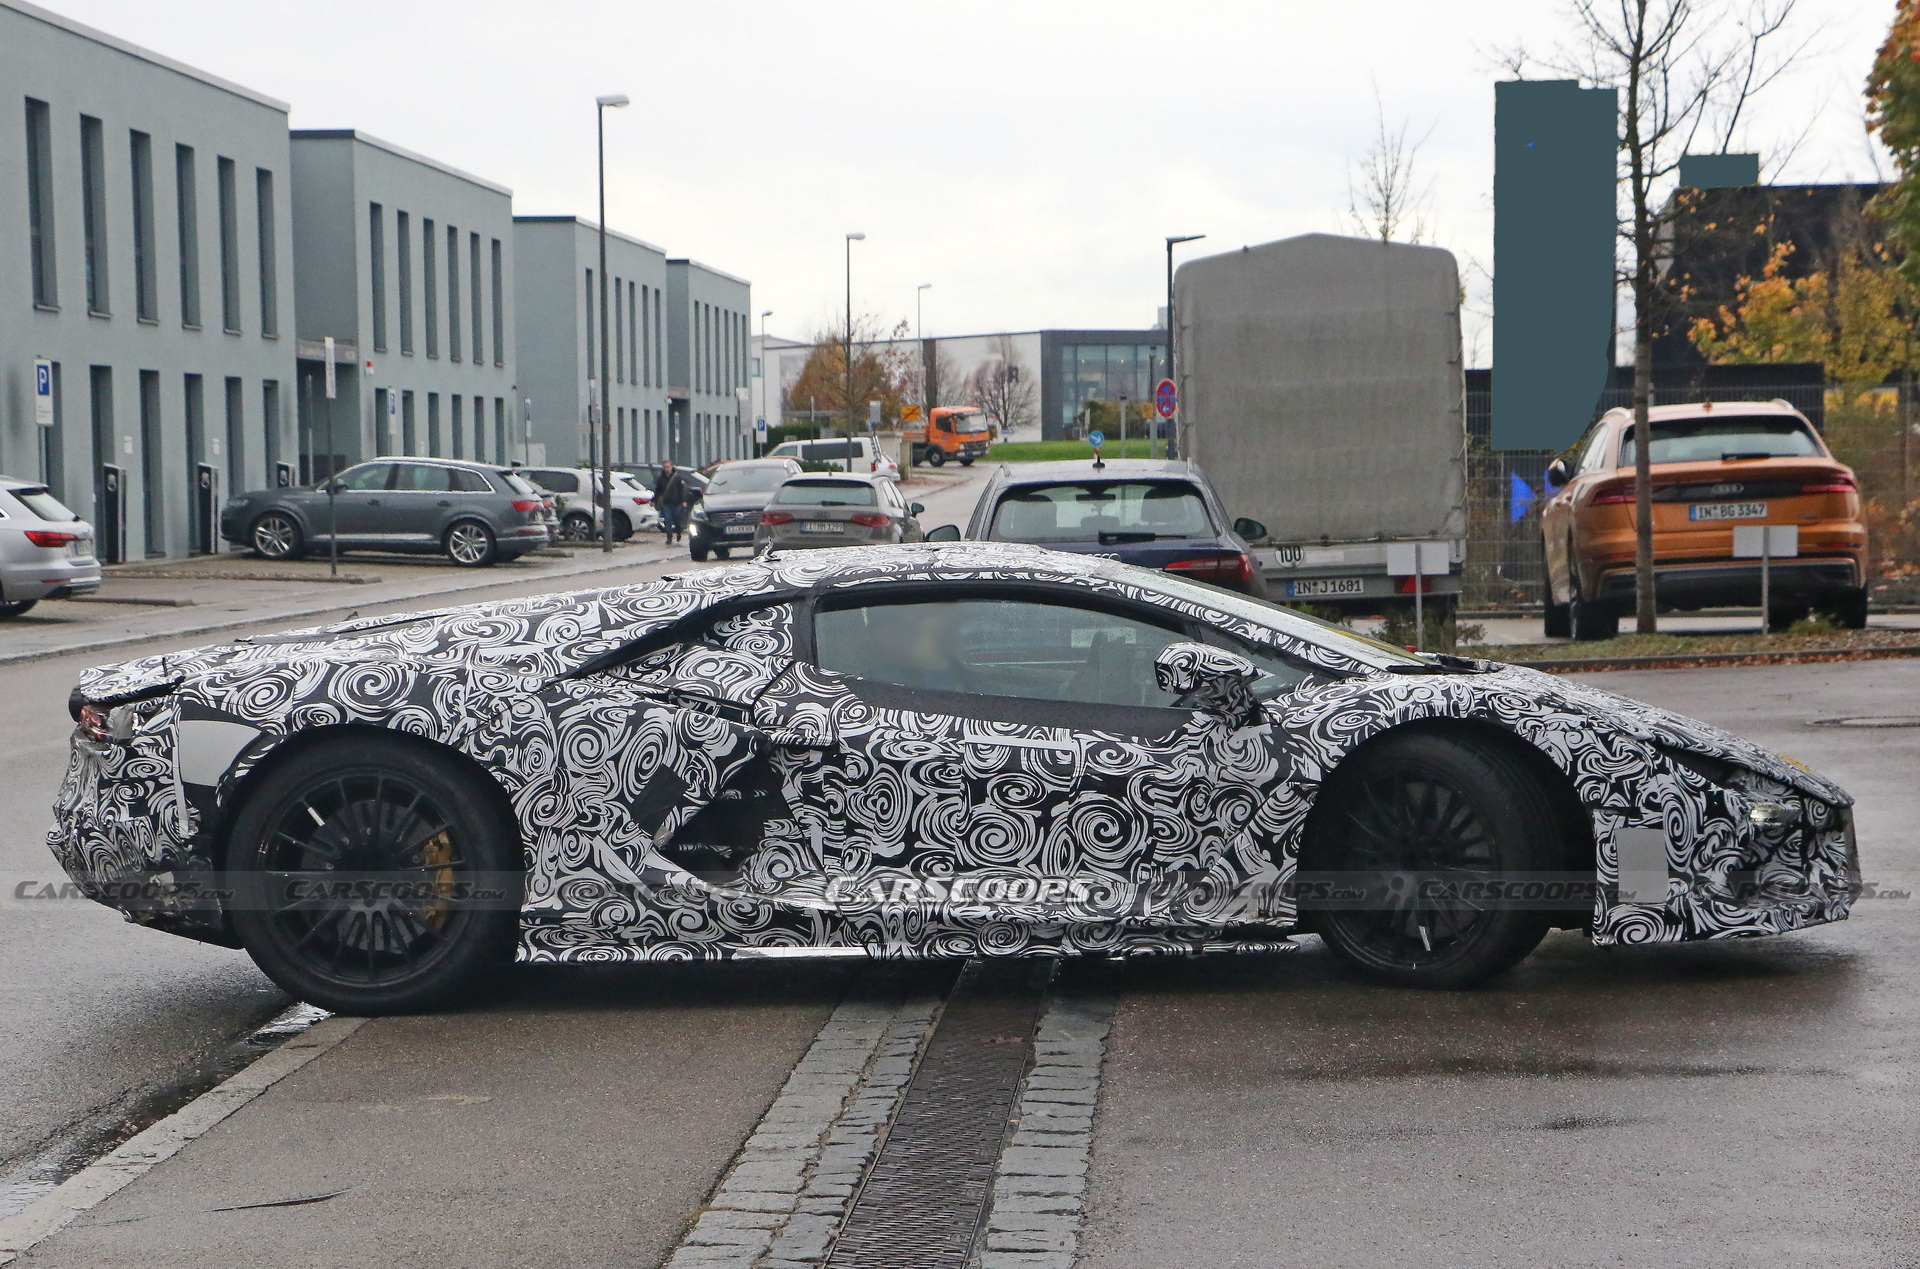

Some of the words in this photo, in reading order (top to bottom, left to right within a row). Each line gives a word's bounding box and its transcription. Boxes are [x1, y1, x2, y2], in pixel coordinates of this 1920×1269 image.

[39, 367, 47, 392] P
[1699, 505, 1712, 519] IN
[1280, 546, 1302, 563] 100
